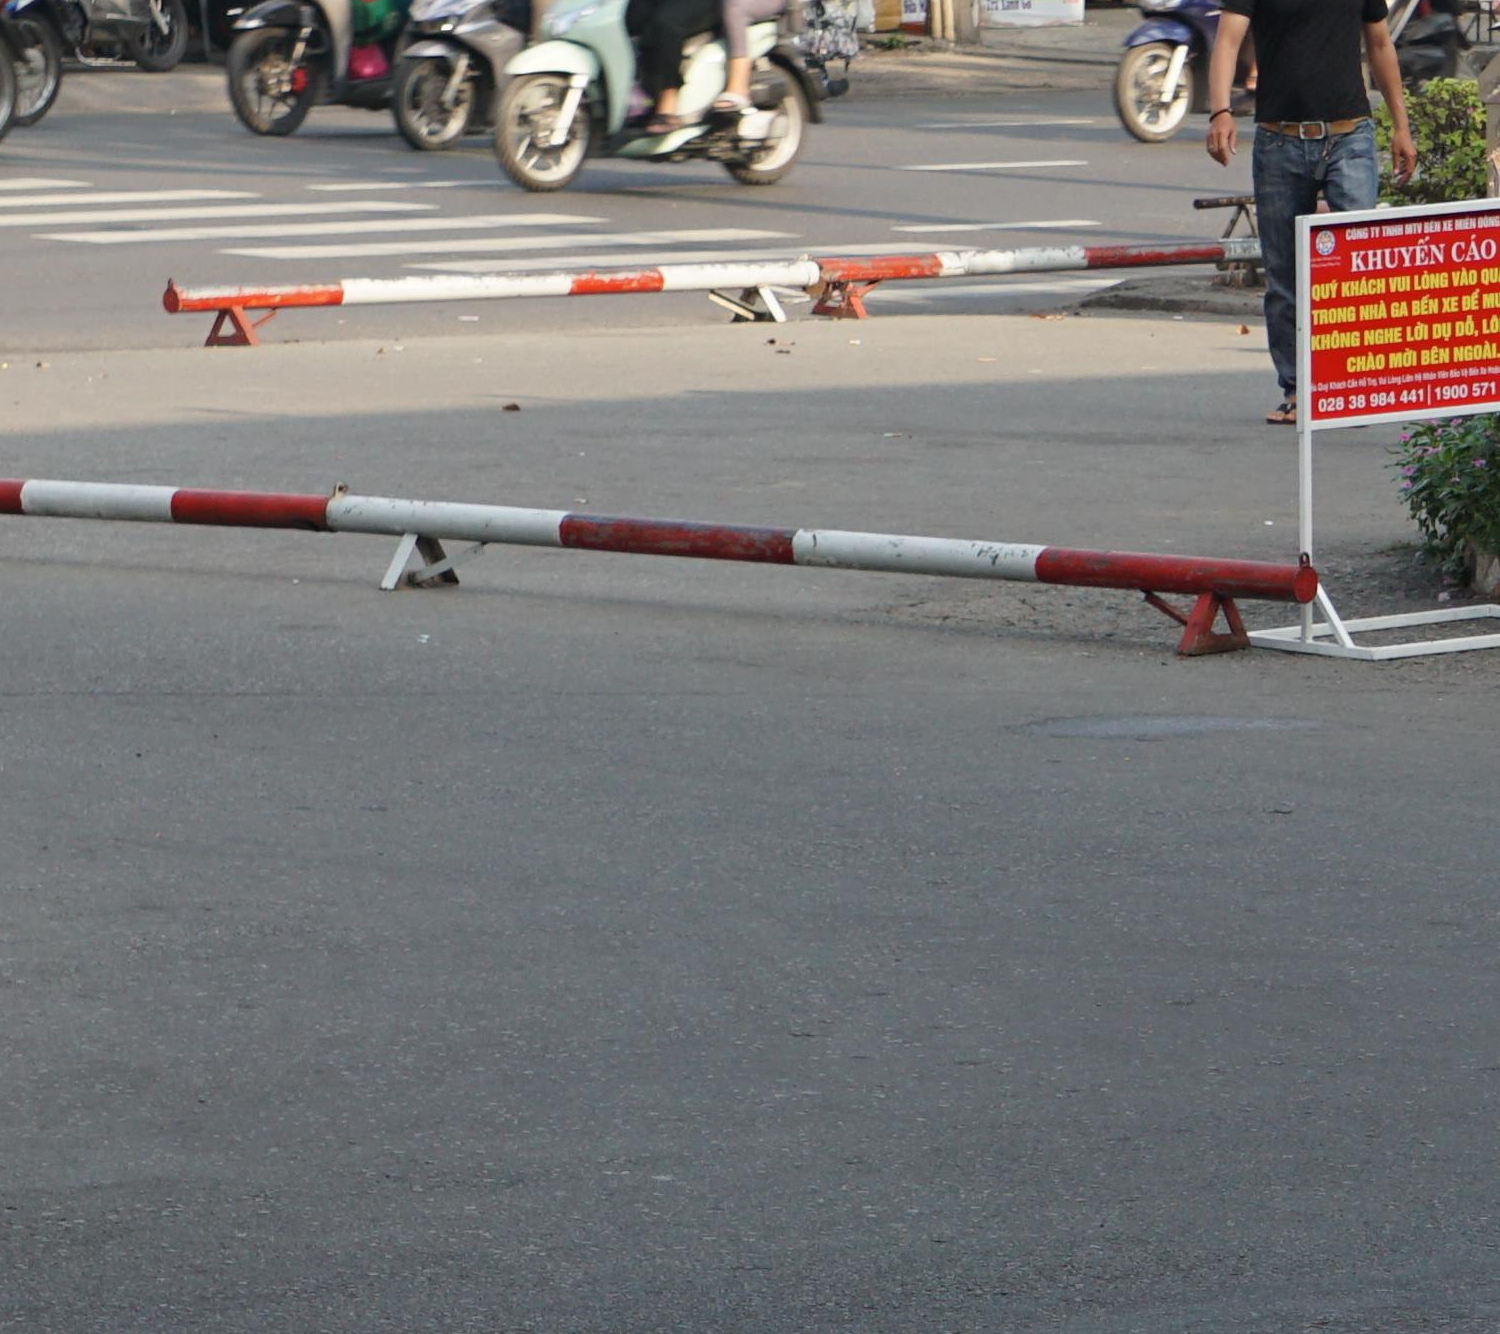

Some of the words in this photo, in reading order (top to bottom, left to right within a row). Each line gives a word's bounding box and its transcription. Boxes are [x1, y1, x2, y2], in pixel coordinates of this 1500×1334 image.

[1345, 226, 1369, 241] CÔNG
[1370, 226, 1380, 238] TY
[1381, 224, 1404, 238] TNHH
[1405, 221, 1423, 236] MTV
[1442, 219, 1453, 233] XE
[1477, 215, 1500, 229] ĐÔNG
[1350, 236, 1446, 273] KHUYẾN
[1451, 234, 1498, 263] CÁO
[1311, 281, 1339, 302] QUÝ
[1341, 274, 1386, 298] KHÁCH
[1388, 275, 1411, 293] VUI
[1414, 270, 1448, 291] LÒNG
[1451, 266, 1478, 288] VÀO
[1312, 307, 1357, 326] TRONG
[1360, 300, 1388, 323] NHÀ
[1390, 301, 1408, 319] GA
[1411, 294, 1439, 317] BẾN
[1442, 296, 1459, 314] XE
[1462, 288, 1481, 312] ĐỂ
[1311, 330, 1361, 351] KHÔNG
[1364, 326, 1403, 346] NGHE
[1406, 321, 1429, 342] LỜI
[1432, 322, 1452, 343] DỤ
[1346, 352, 1386, 373] CHÀO
[1389, 349, 1417, 369] MỜI
[1421, 345, 1450, 365] BÊN
[1453, 340, 1500, 363] NGOÀI.
[1318, 396, 1345, 412] 028
[1348, 394, 1366, 410] 38
[1369, 391, 1396, 408] 984
[1400, 389, 1424, 404] 441
[1434, 385, 1469, 401] 1900
[1472, 381, 1496, 397] 571
